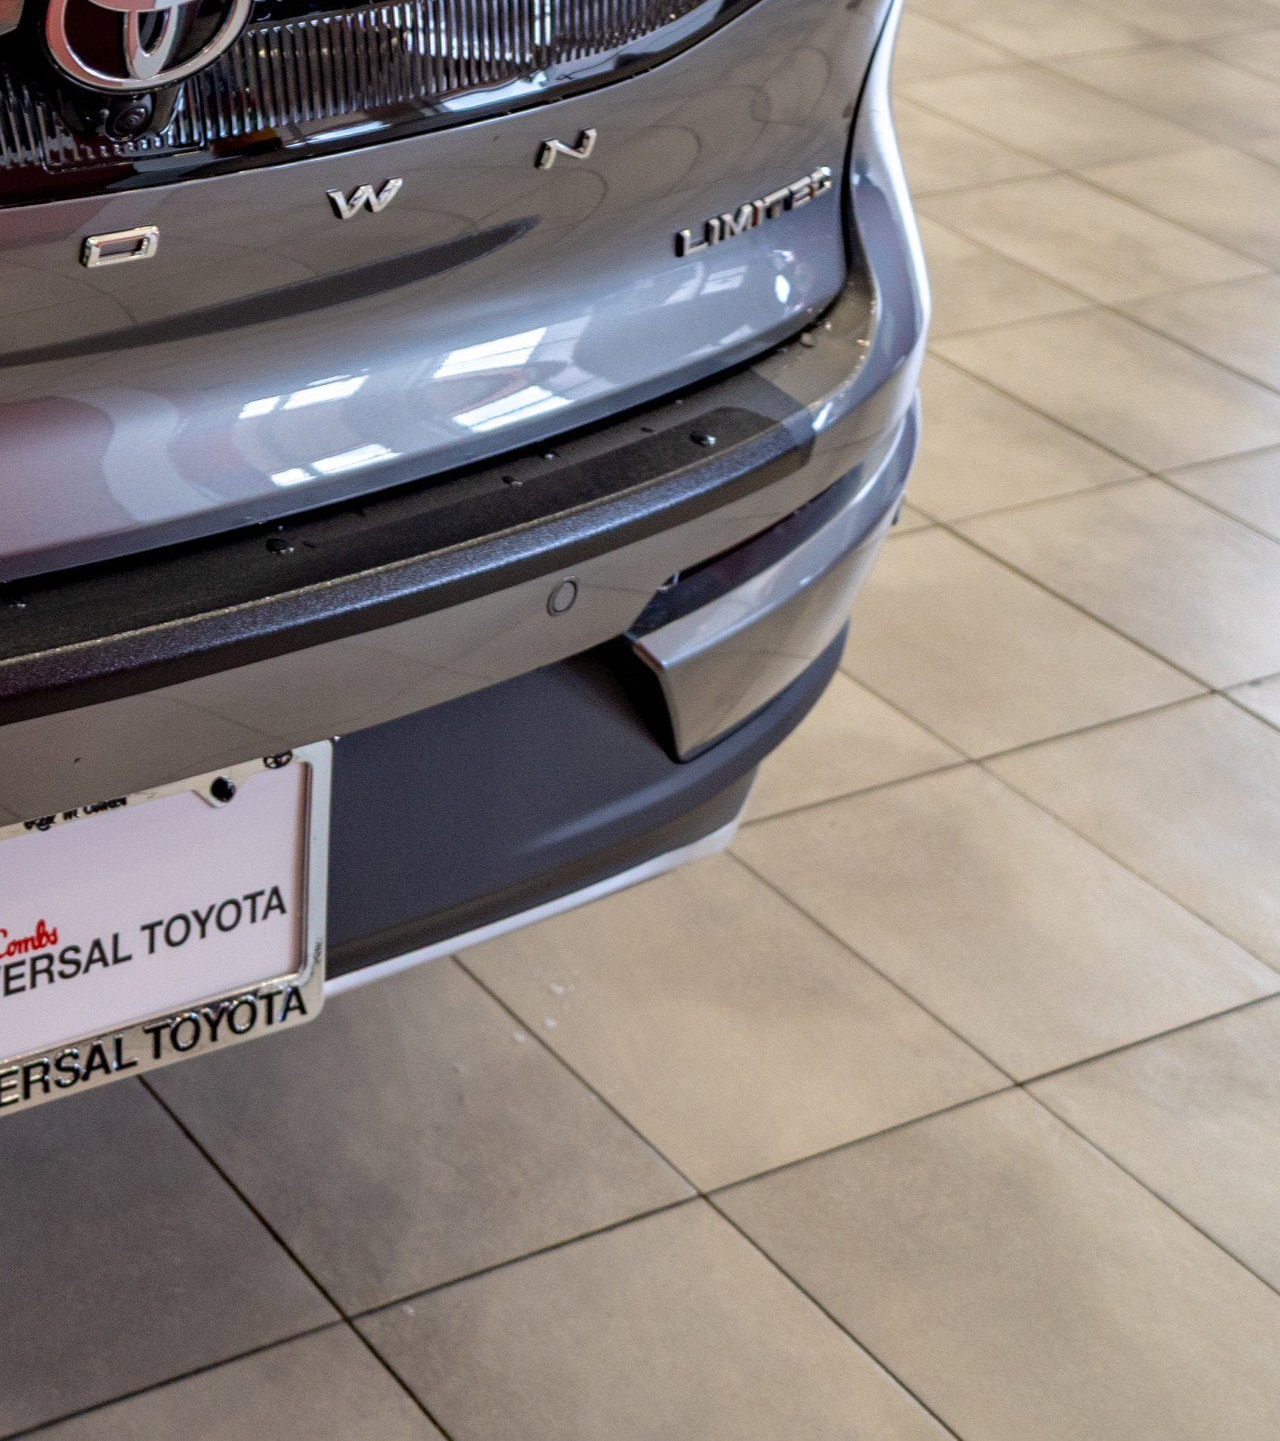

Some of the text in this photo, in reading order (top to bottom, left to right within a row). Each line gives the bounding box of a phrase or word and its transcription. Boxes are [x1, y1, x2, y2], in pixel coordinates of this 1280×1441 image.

[674, 166, 832, 257] LIMITED
[140, 885, 287, 954] TOYOTA
[142, 985, 307, 1060] TOYOTA
